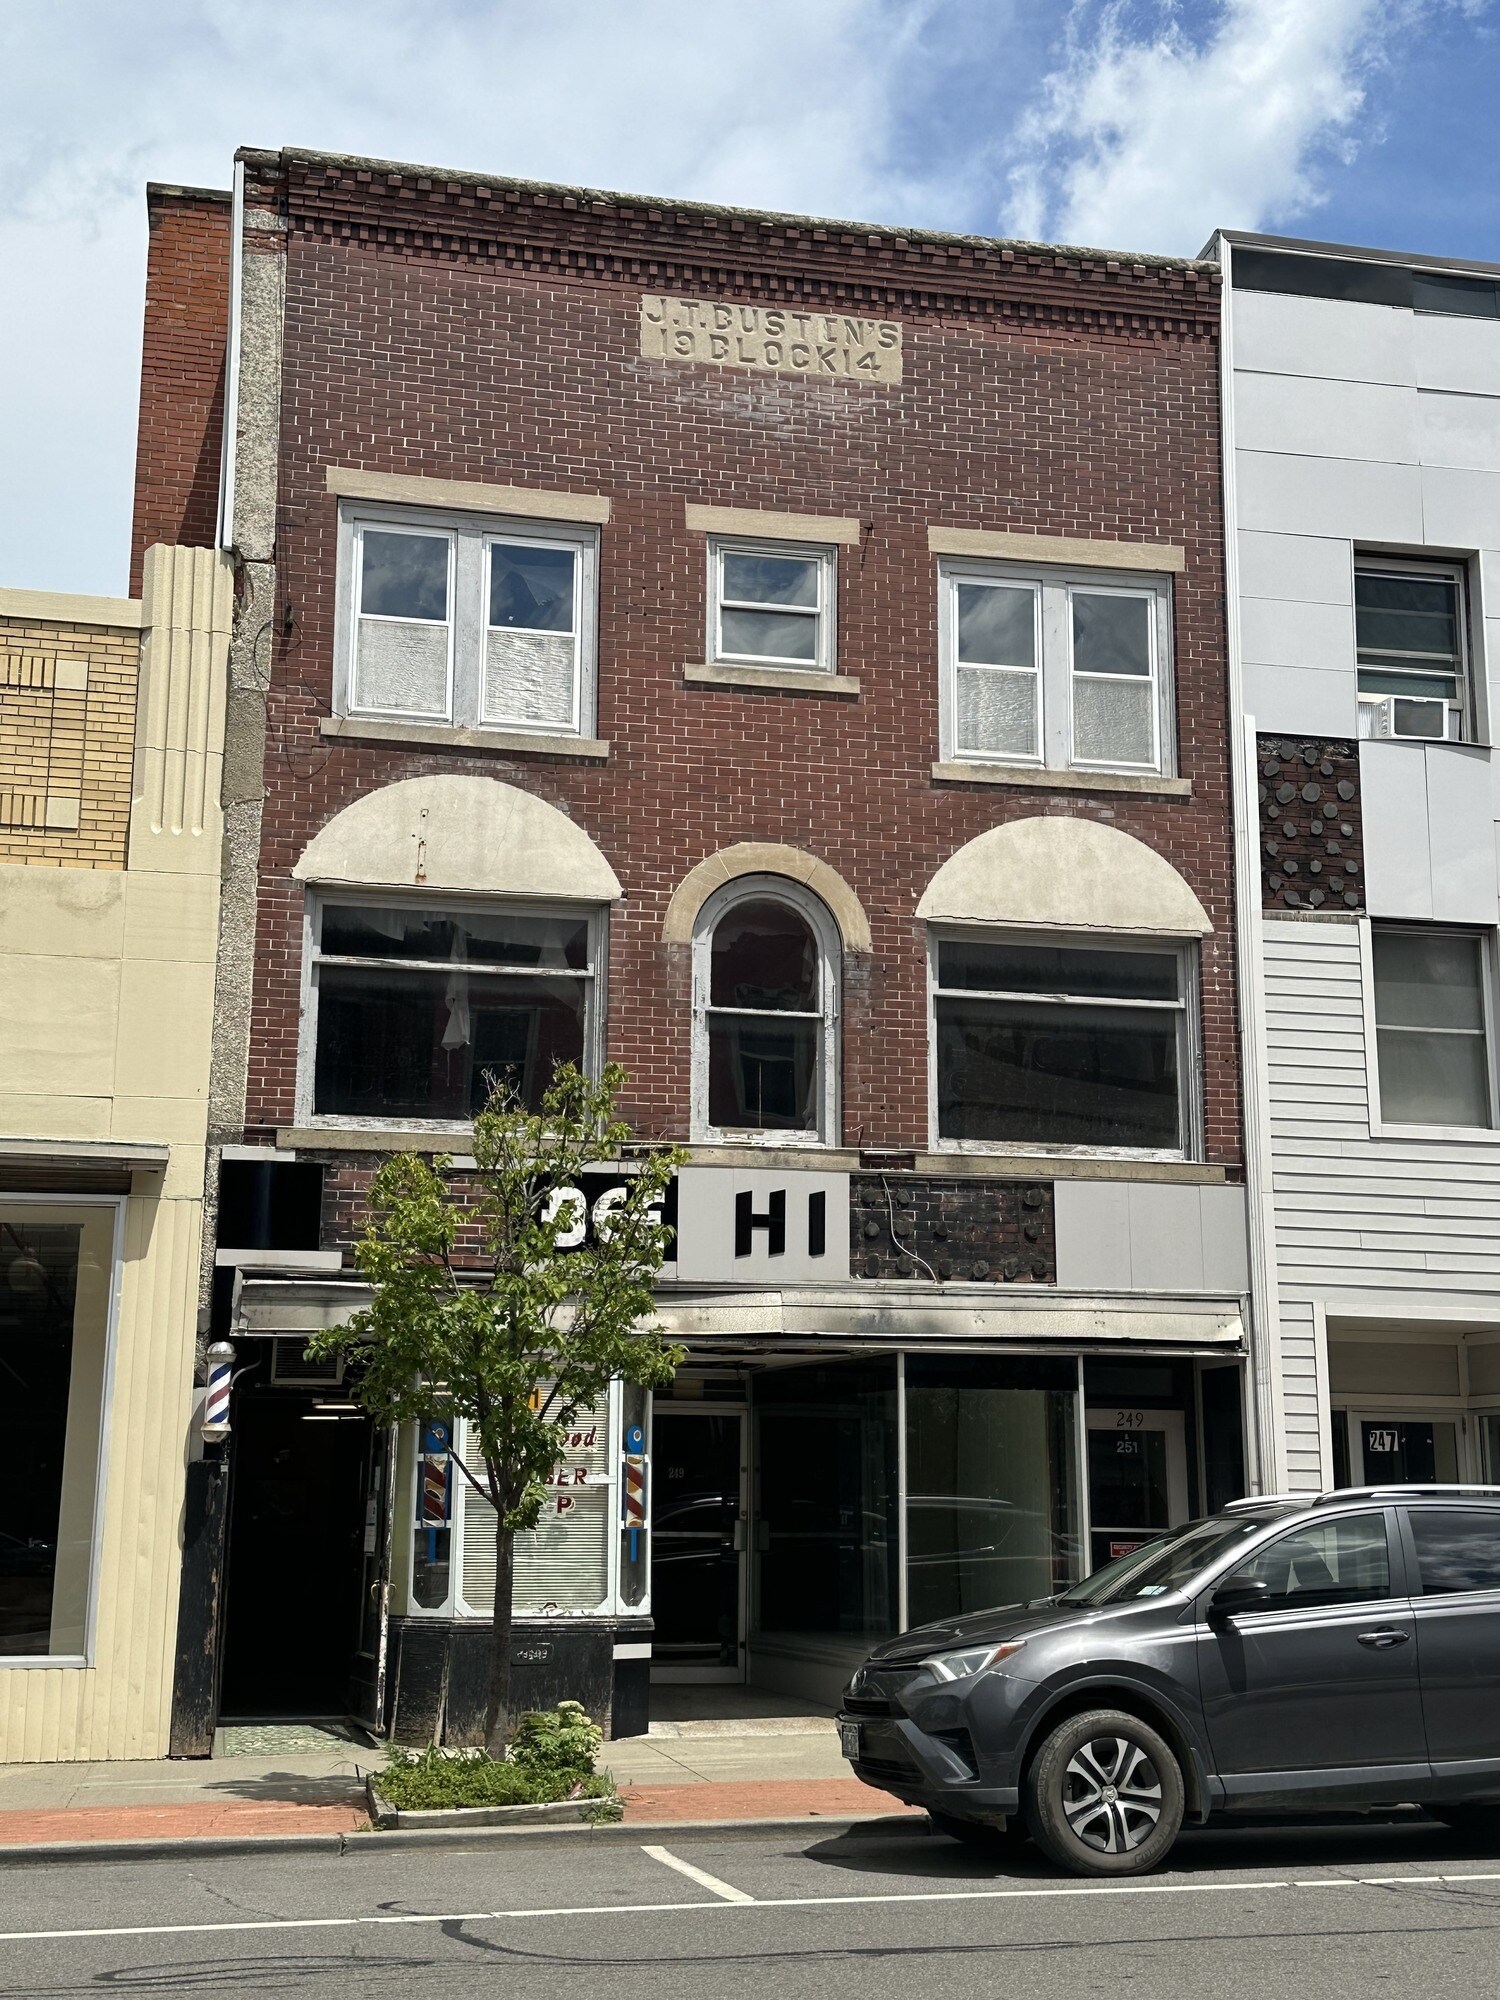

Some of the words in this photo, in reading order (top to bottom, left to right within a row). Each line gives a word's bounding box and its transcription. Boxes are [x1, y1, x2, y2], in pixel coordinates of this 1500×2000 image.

[660, 328, 696, 358] 19
[709, 333, 836, 374] BLOCK
[843, 348, 882, 379] 14
[735, 1189, 826, 1258] HI
[1117, 1411, 1144, 1428] 249
[1117, 1441, 1138, 1453] 251
[1370, 1431, 1396, 1451] 247
[668, 1467, 685, 1478] 249
